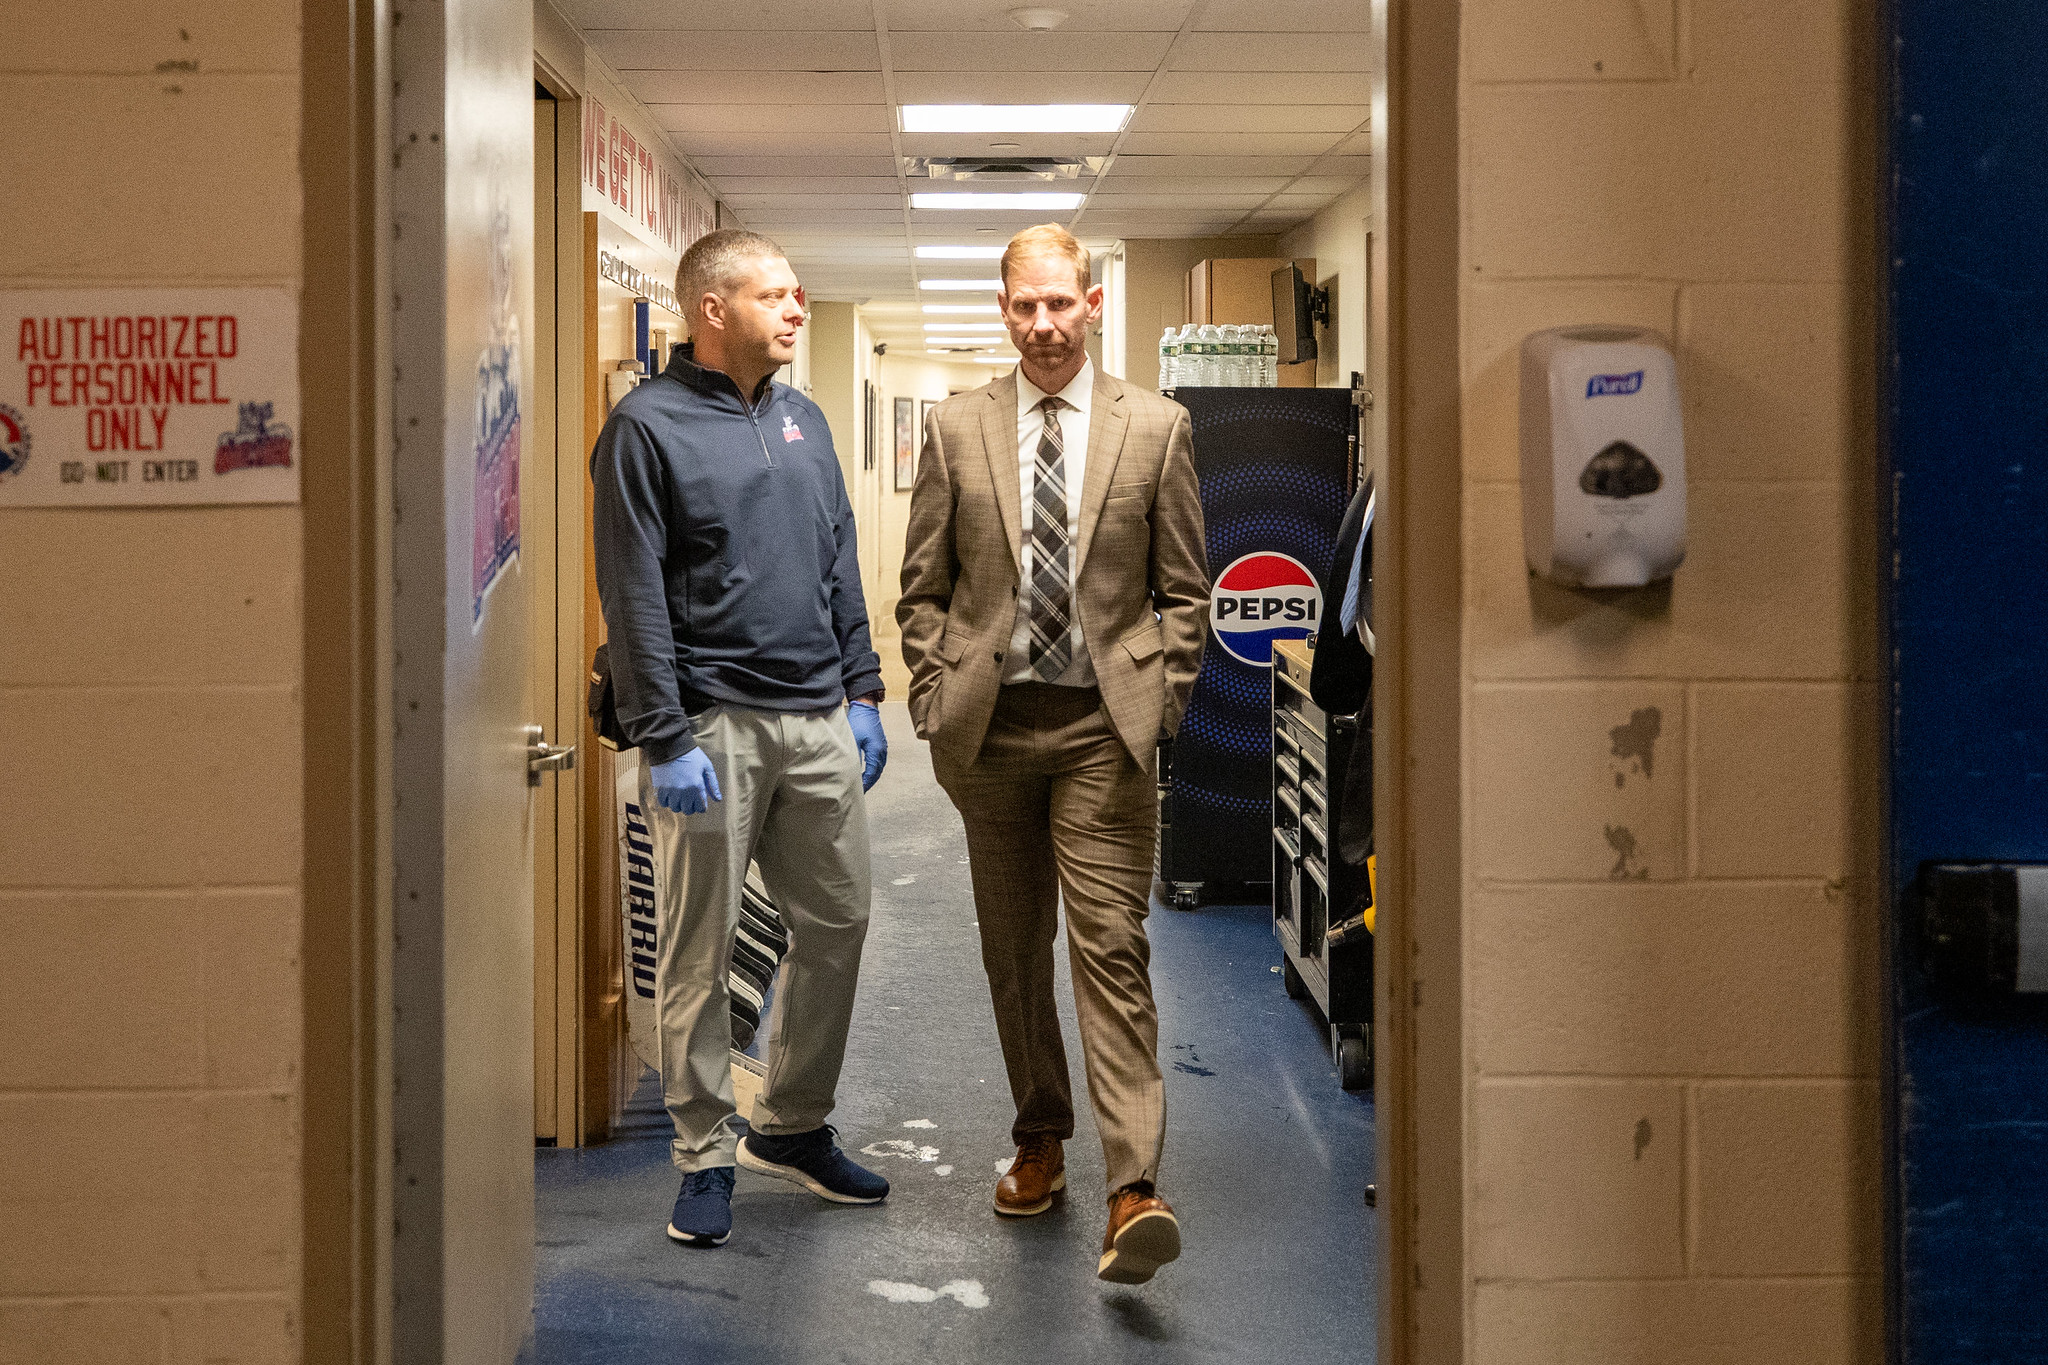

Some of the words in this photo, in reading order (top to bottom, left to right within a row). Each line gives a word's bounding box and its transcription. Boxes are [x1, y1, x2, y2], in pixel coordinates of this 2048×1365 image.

[609, 115, 636, 218] GET
[659, 164, 679, 252] NOT
[19, 315, 238, 361] AUTHORIZED
[26, 362, 231, 407] PERSONNEL
[86, 407, 169, 451] ONLY
[60, 461, 84, 483] DO
[96, 461, 129, 483] NOT
[142, 460, 199, 482] ENTER
[1216, 597, 1316, 622] PEPSI
